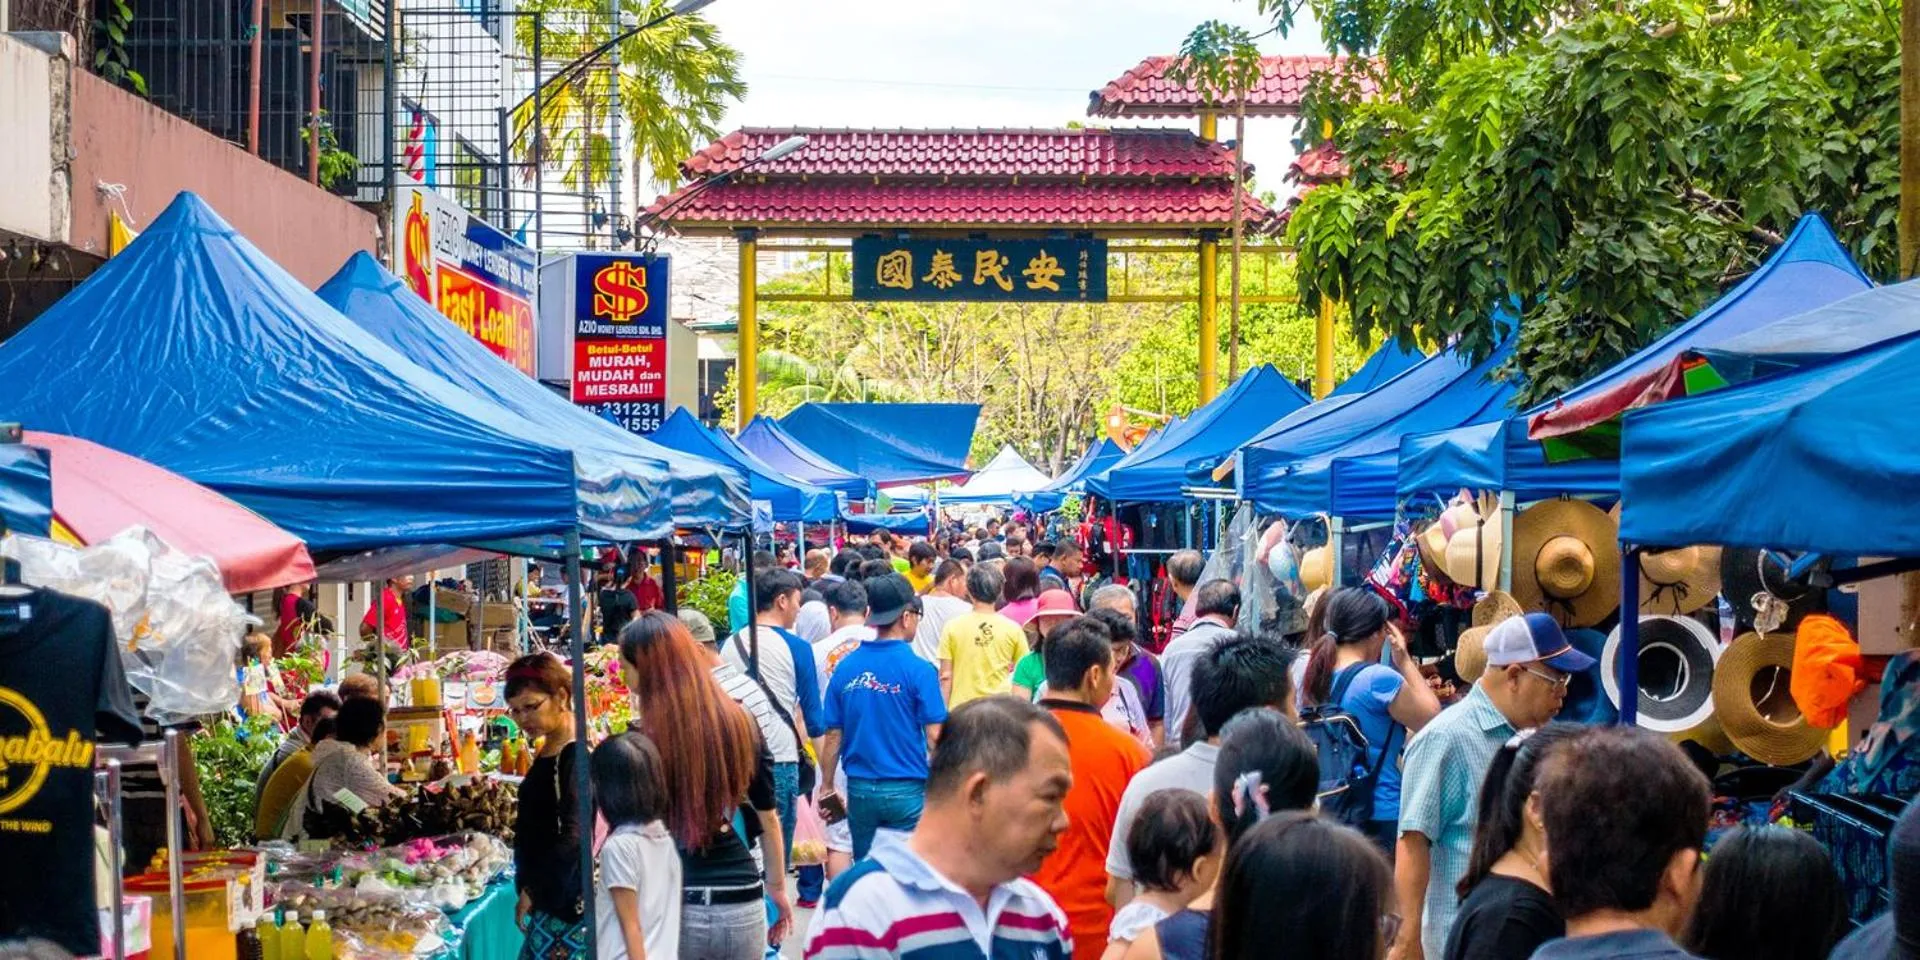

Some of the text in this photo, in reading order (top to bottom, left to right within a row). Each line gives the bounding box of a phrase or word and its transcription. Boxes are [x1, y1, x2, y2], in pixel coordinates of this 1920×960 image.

[876, 248, 1066, 292] 國泰民安
[441, 273, 475, 335] Fast
[480, 291, 516, 349] Loan!
[579, 320, 597, 334] AZIO
[598, 325, 614, 334] MONEY
[616, 326, 637, 335] LENDERS
[588, 344, 653, 354] Betul-Betul
[589, 355, 651, 368] MURAH,
[578, 370, 661, 382] MUDAH dan
[585, 383, 653, 396] MESRA!!!
[0, 729, 94, 768] abalu
[1, 821, 52, 832] THE WIND
